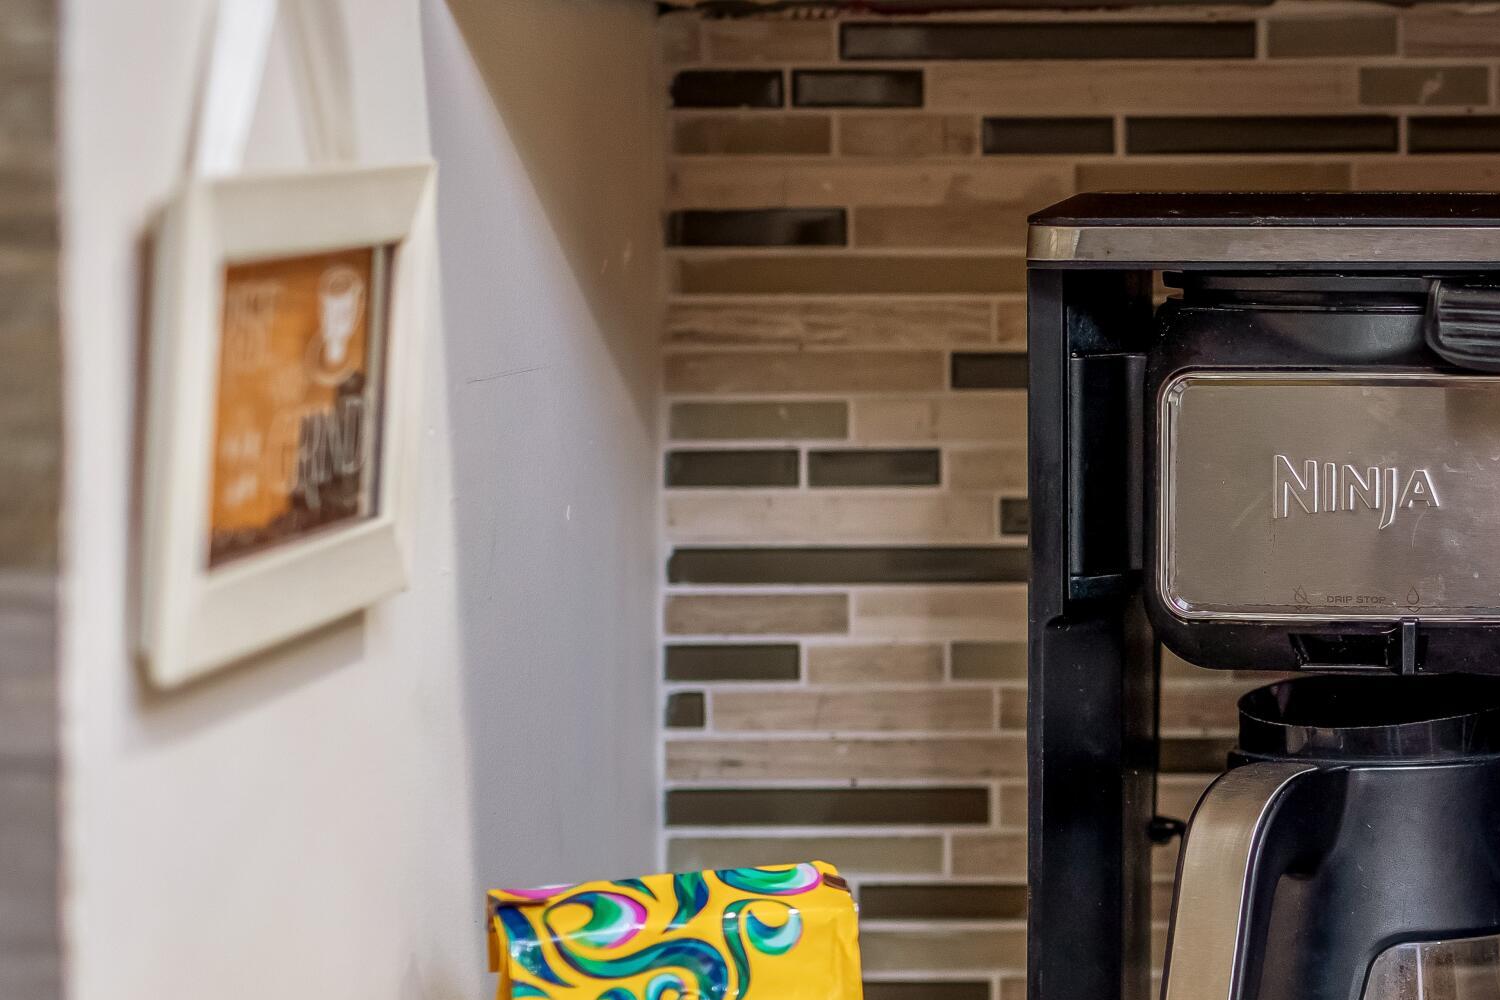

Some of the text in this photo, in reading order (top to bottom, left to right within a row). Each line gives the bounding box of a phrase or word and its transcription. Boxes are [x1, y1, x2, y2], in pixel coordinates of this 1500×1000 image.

[1273, 454, 1440, 530] NINJA
[1326, 595, 1386, 604] DRIP STOP
